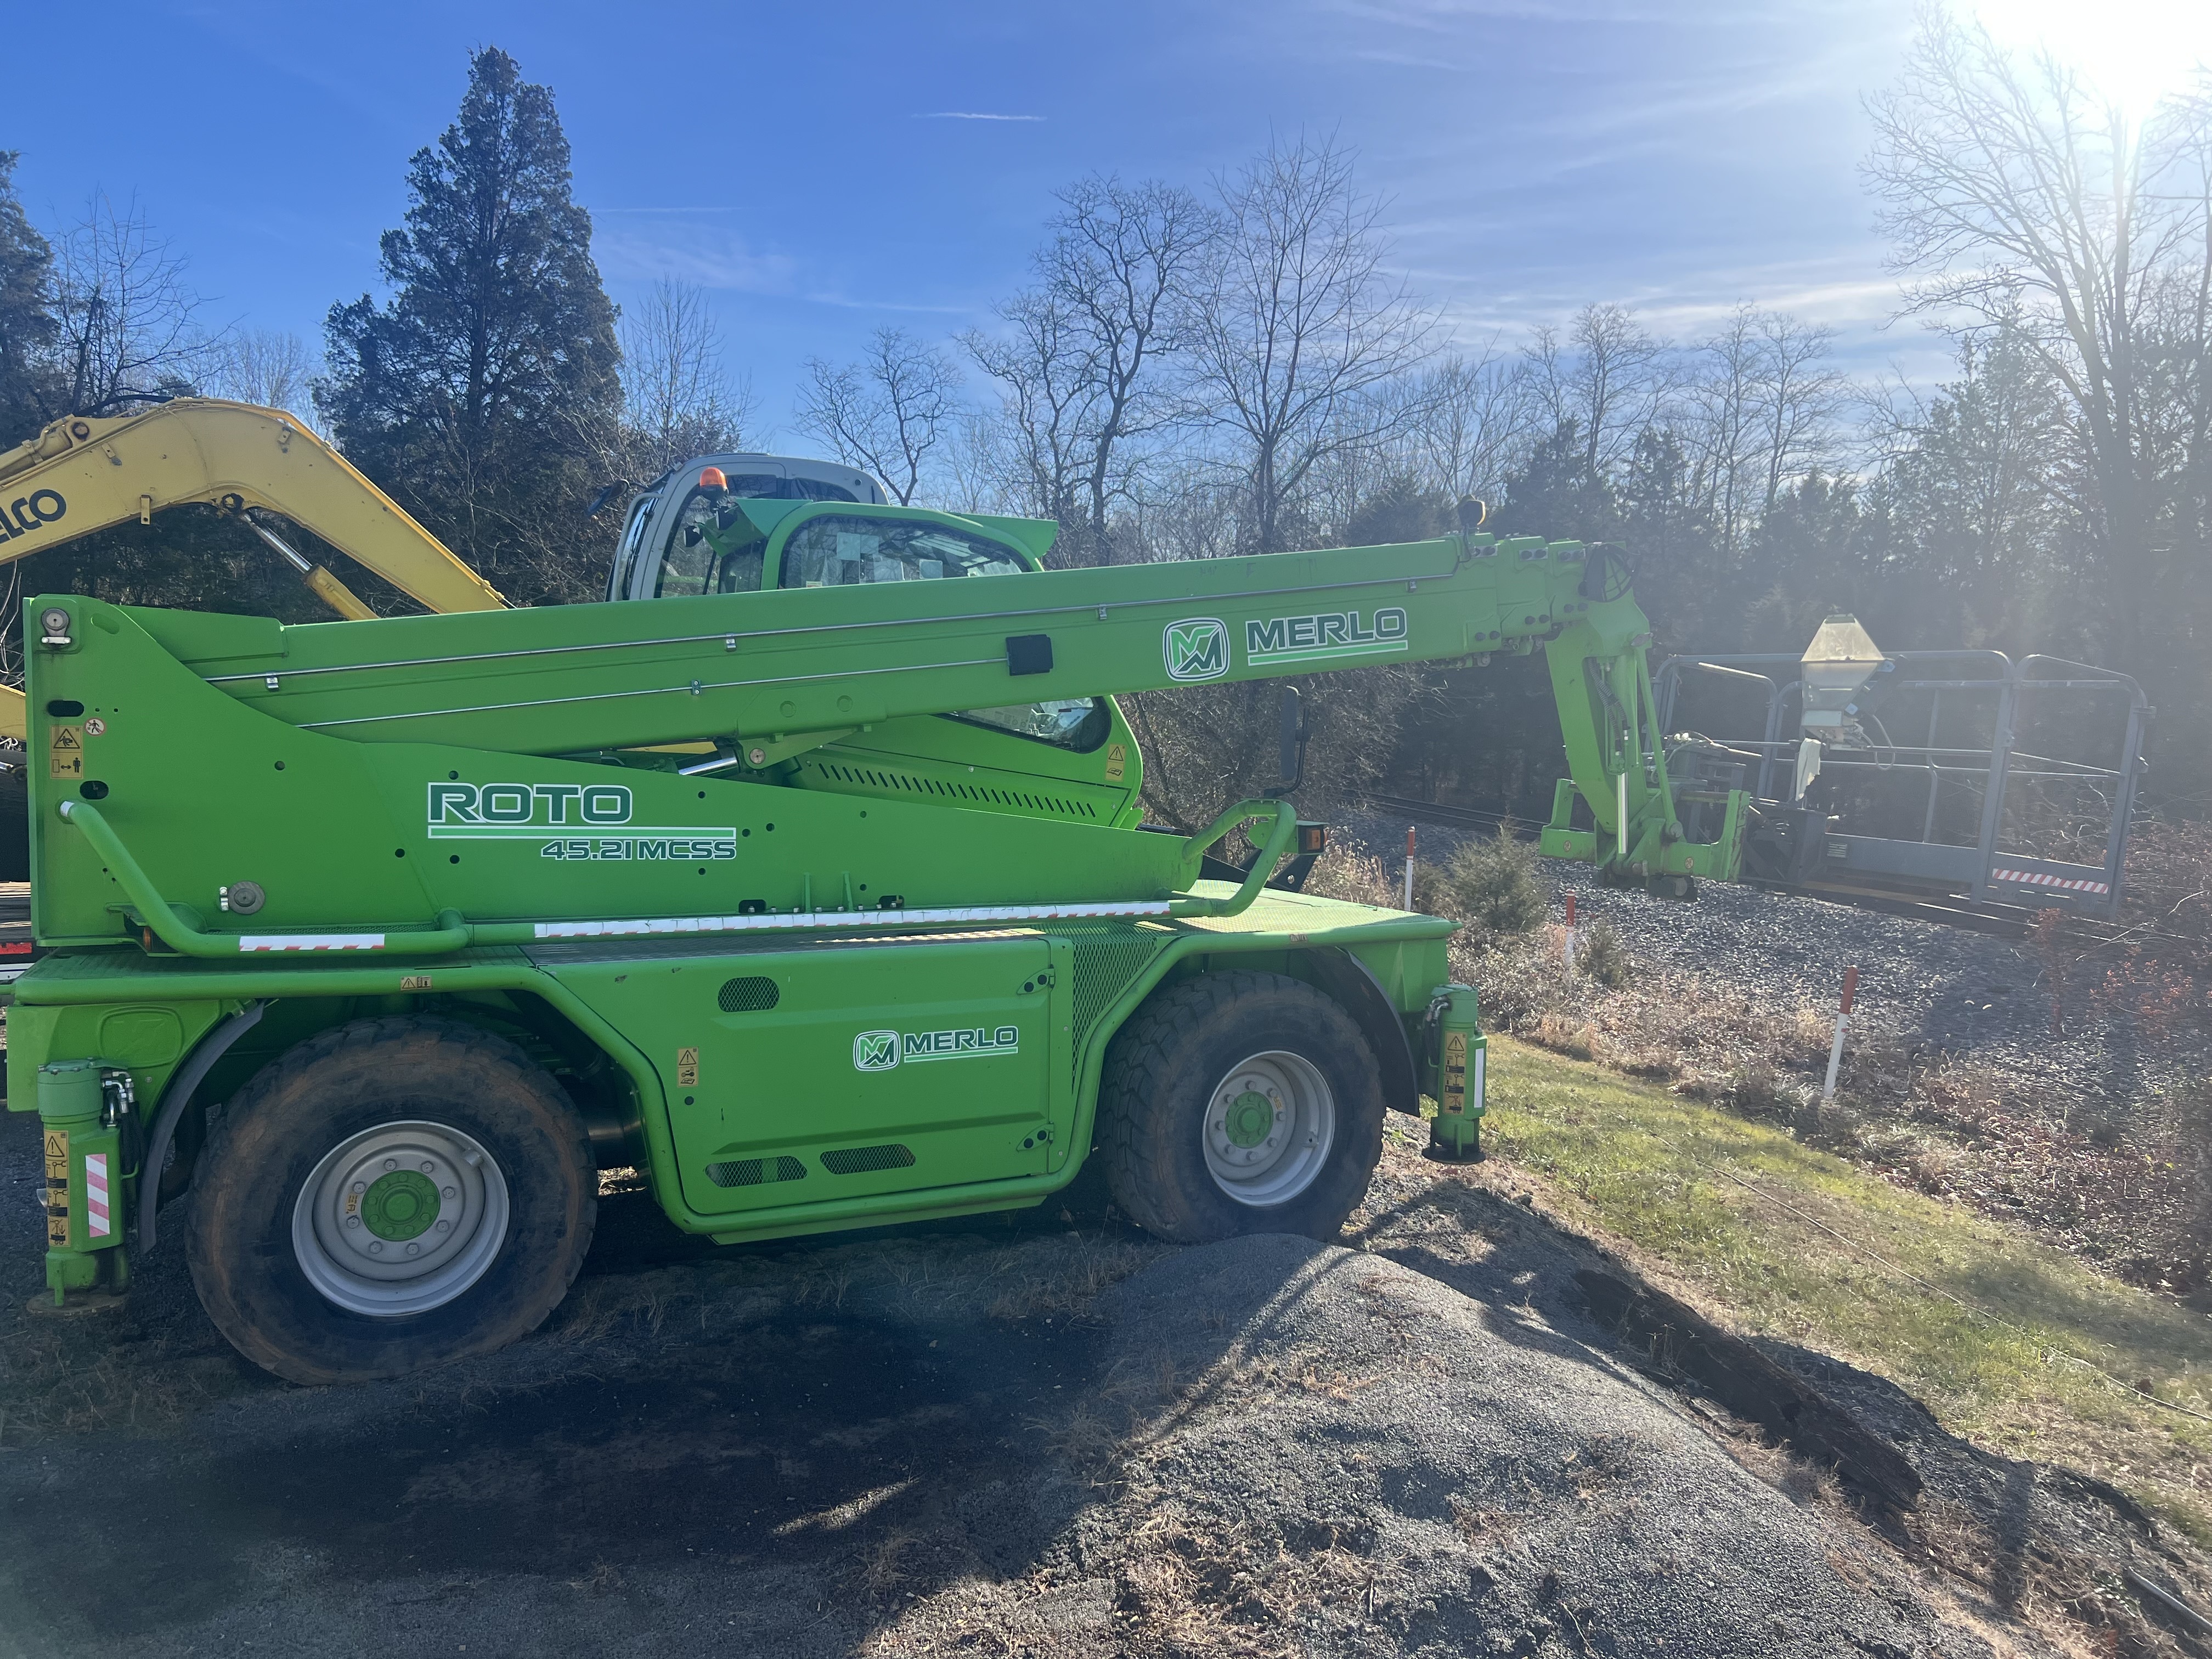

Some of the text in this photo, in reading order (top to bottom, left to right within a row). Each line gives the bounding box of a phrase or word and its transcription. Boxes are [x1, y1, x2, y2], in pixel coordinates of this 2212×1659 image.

[1245, 607, 1407, 653] MERLO
[428, 782, 633, 824] ROTO
[541, 840, 736, 860] 45.21 MCSS
[904, 1025, 1019, 1054] MERLO
